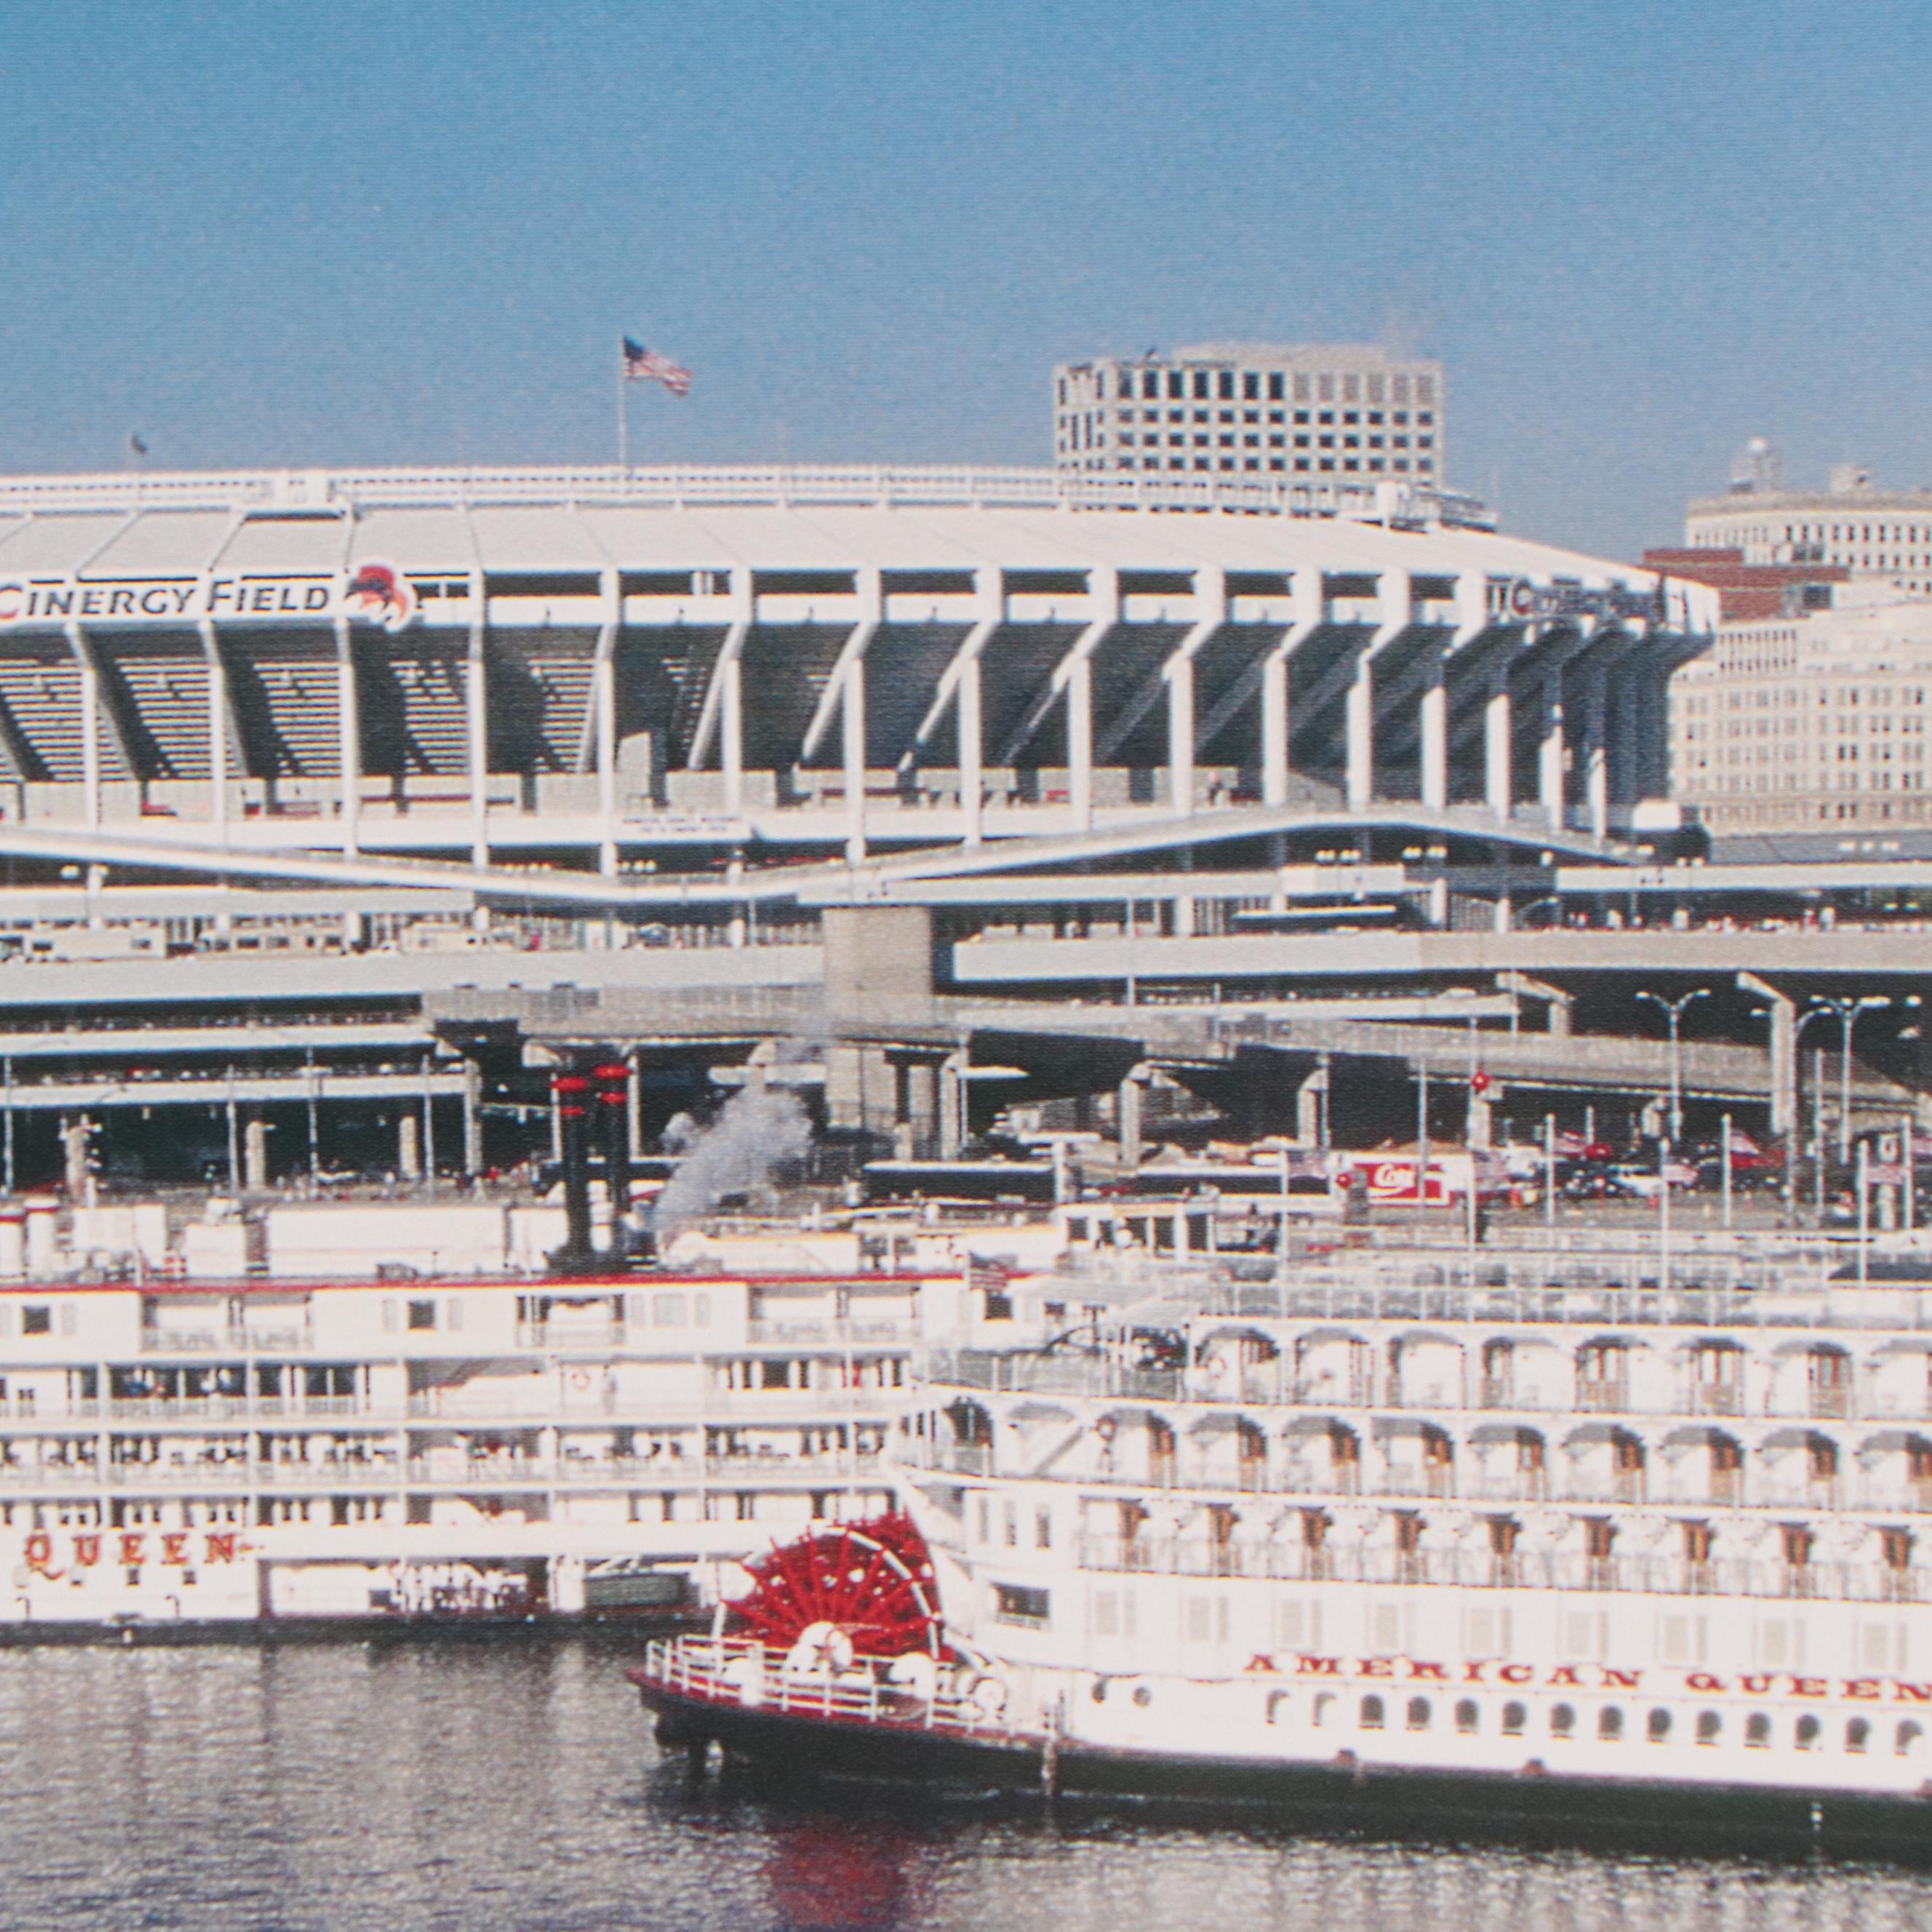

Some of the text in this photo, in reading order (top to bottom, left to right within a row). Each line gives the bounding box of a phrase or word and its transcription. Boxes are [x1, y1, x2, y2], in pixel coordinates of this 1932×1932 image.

[0, 580, 329, 618] CINERGY FIELD
[25, 1533, 242, 1580] QUEEN
[1245, 1653, 1932, 1701] AMERICAN QUEEN
